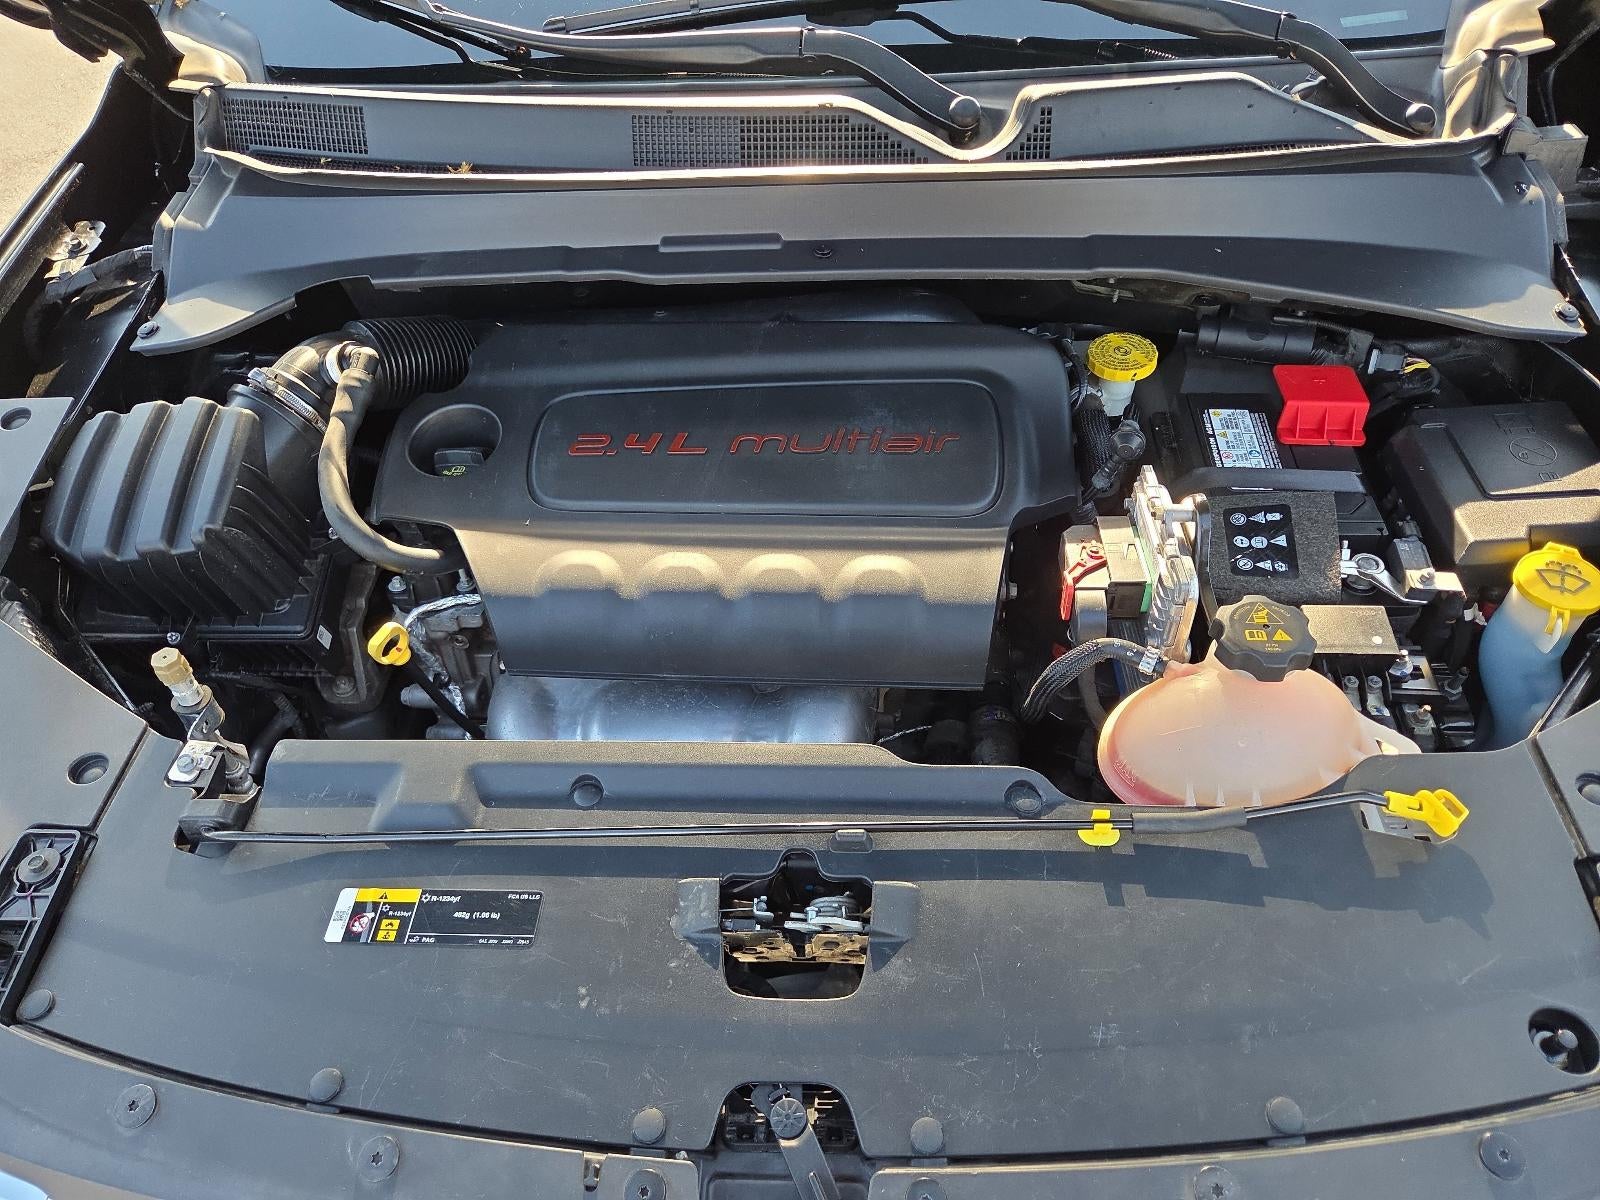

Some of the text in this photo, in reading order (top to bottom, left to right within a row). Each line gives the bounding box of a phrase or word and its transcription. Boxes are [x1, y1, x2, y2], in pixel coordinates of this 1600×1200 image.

[730, 425, 961, 455] multiair
[430, 895, 462, 904] R-1234yf
[490, 911, 501, 920] lb)
